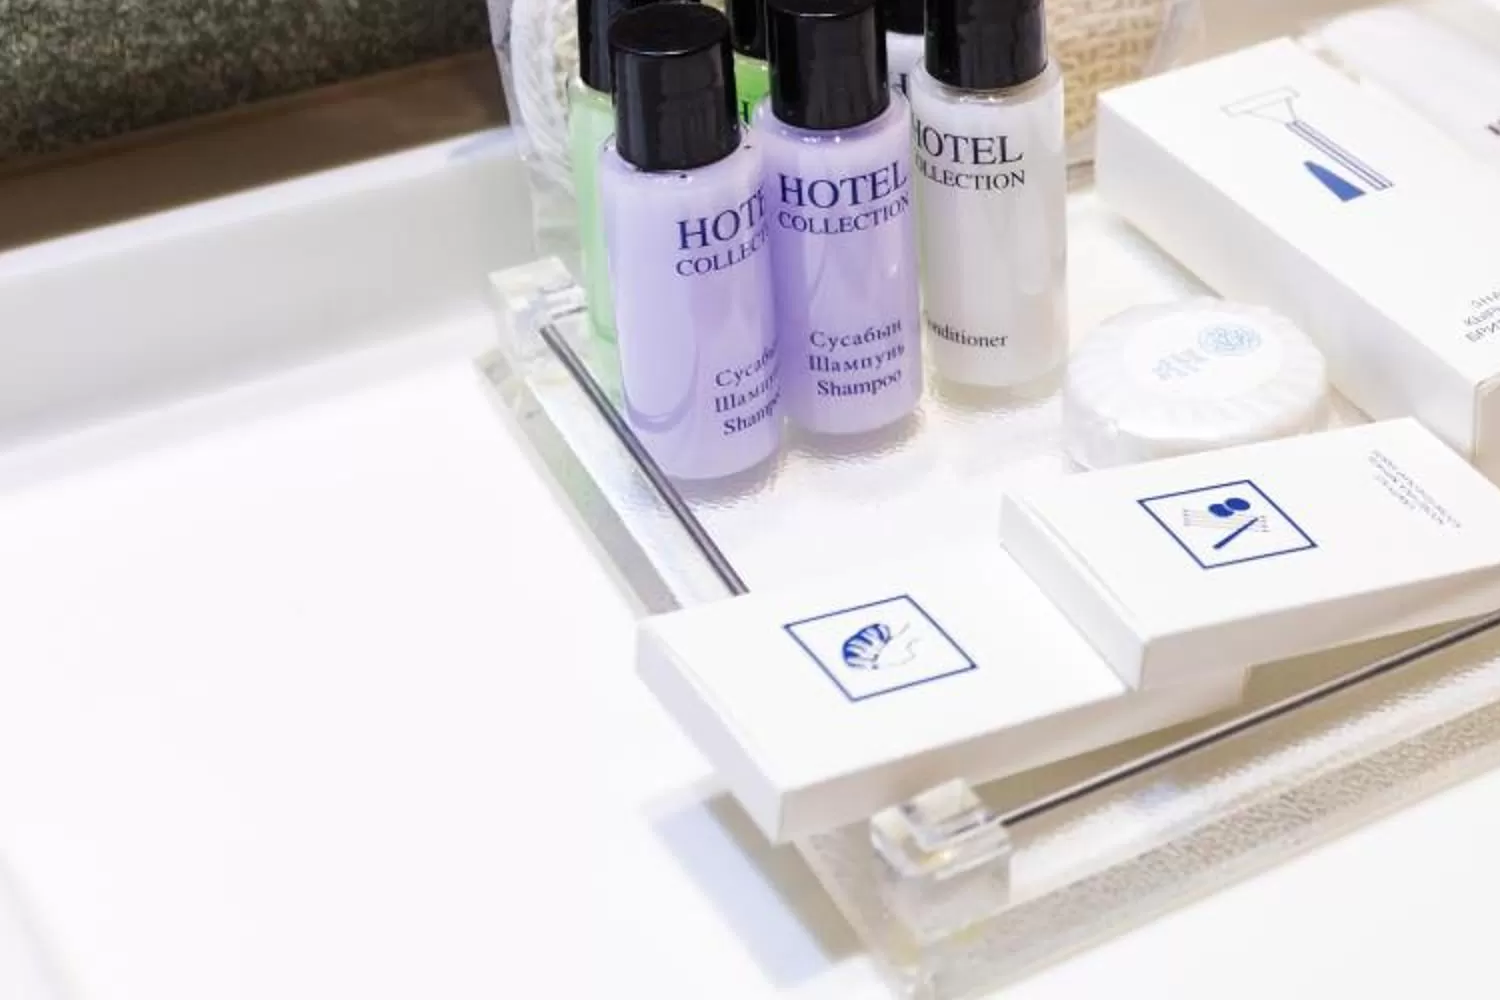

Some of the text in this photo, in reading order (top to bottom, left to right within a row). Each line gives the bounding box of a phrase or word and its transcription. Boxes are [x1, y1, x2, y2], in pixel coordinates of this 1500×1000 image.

[778, 161, 908, 209] HOTEL
[915, 153, 1025, 190] LLECTION
[676, 183, 765, 250] HOT
[778, 192, 910, 235] COLLECTION
[809, 319, 902, 352] Сусабын
[927, 318, 1009, 348] nditioner
[808, 344, 906, 373] Шампунь
[816, 369, 902, 398] Shampoo
